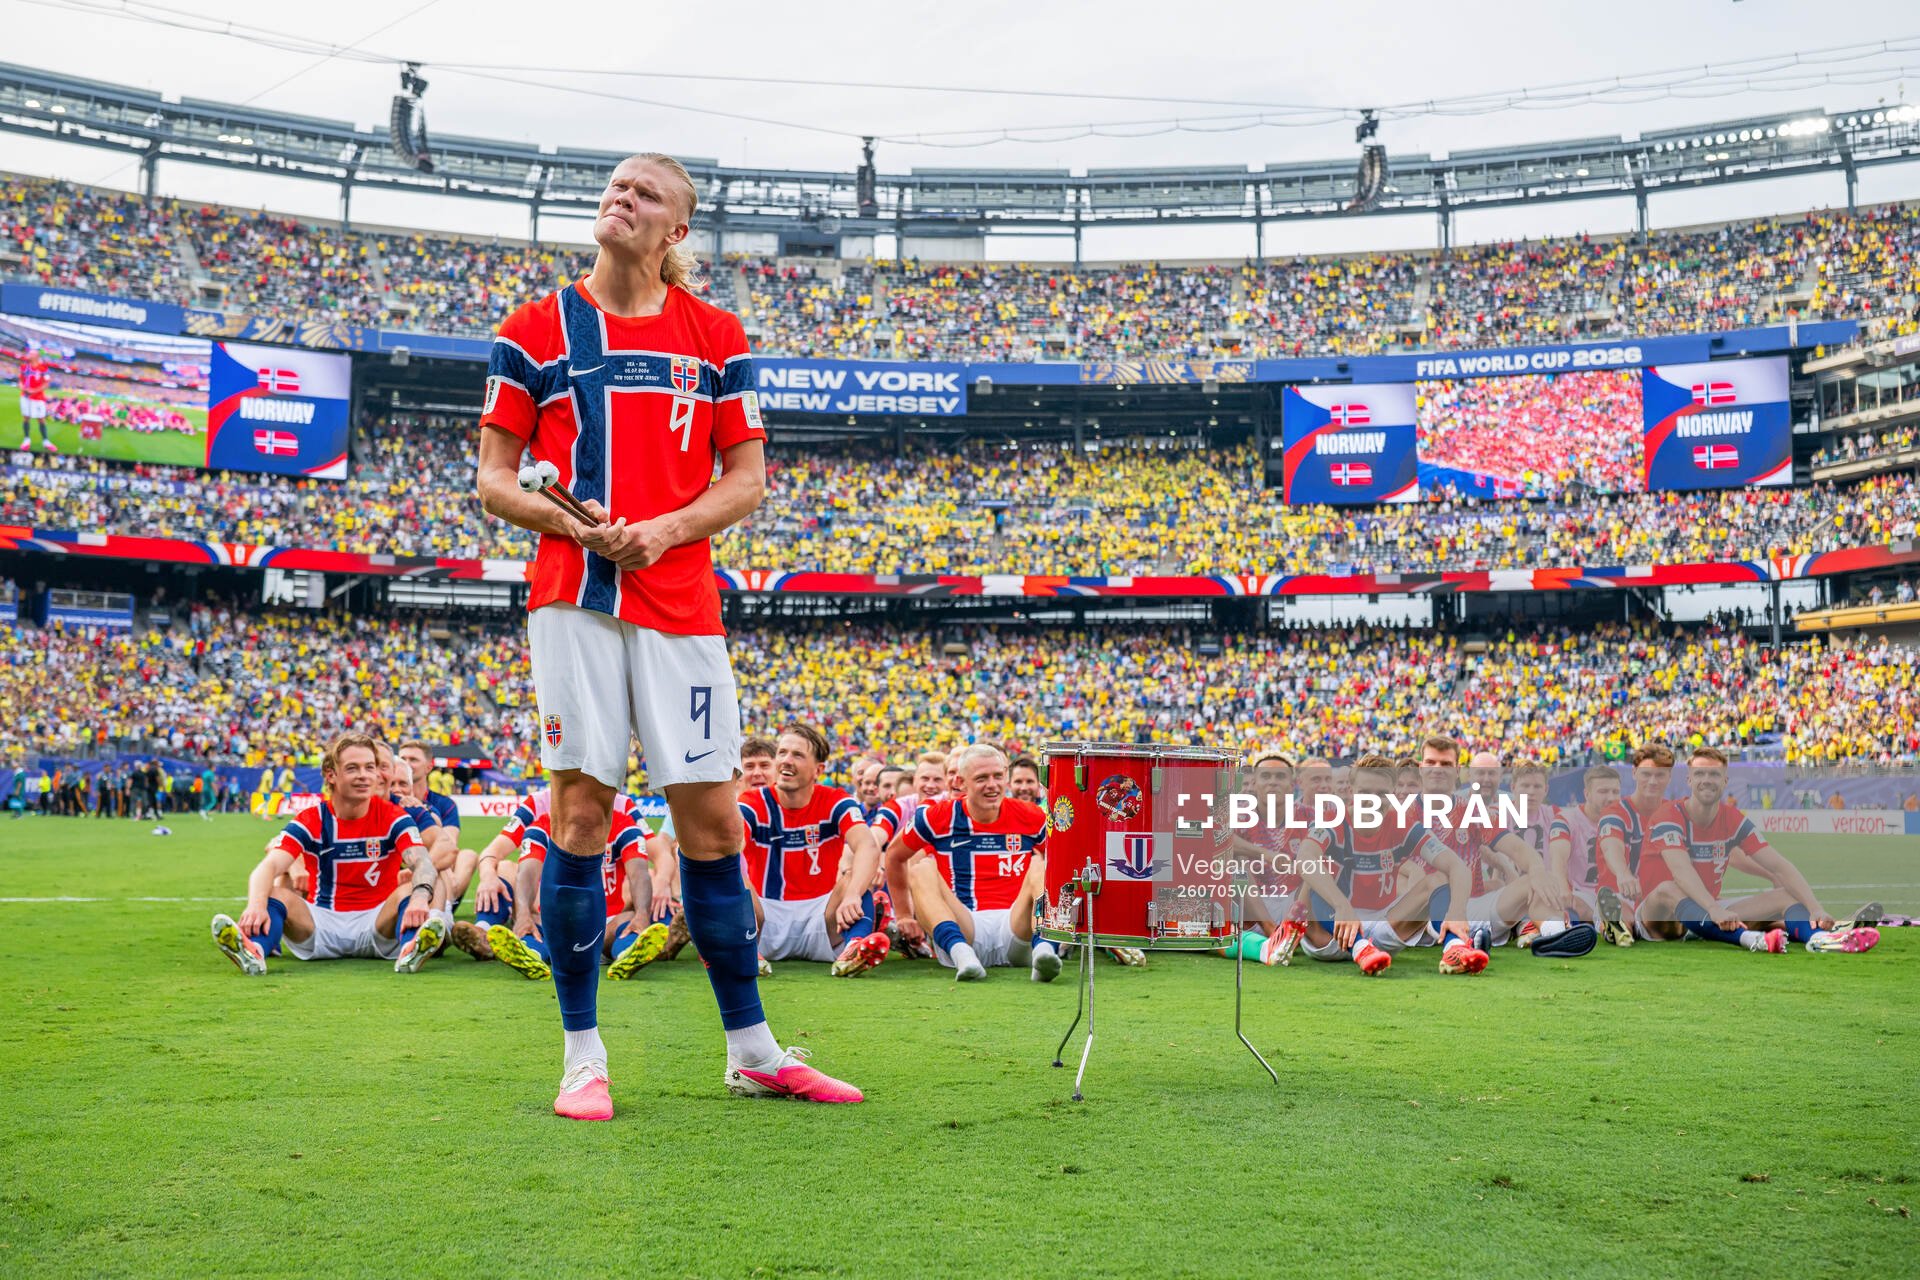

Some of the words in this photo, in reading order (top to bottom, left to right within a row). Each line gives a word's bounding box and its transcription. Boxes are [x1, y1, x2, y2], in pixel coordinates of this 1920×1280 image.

[39, 292, 147, 325] #FIFAWorldCup
[1417, 359, 1457, 377] FIFA
[1459, 354, 1529, 374] WORLD
[1531, 350, 1570, 369] CUP
[1572, 347, 1642, 367] 2026
[759, 368, 847, 390] NEW
[854, 371, 960, 392] YORK
[240, 397, 315, 424] NORWAY
[759, 392, 831, 410] NEW
[836, 395, 960, 413] JERSEY
[669, 395, 696, 452] 9
[1677, 411, 1753, 438] NORWAY
[1316, 432, 1386, 455] NORWAY
[690, 686, 711, 739] 9
[480, 796, 521, 817] veri
[1763, 810, 1809, 833] verizon
[1832, 810, 1885, 834] verizon
[364, 861, 381, 887] 6
[807, 848, 821, 876] 8
